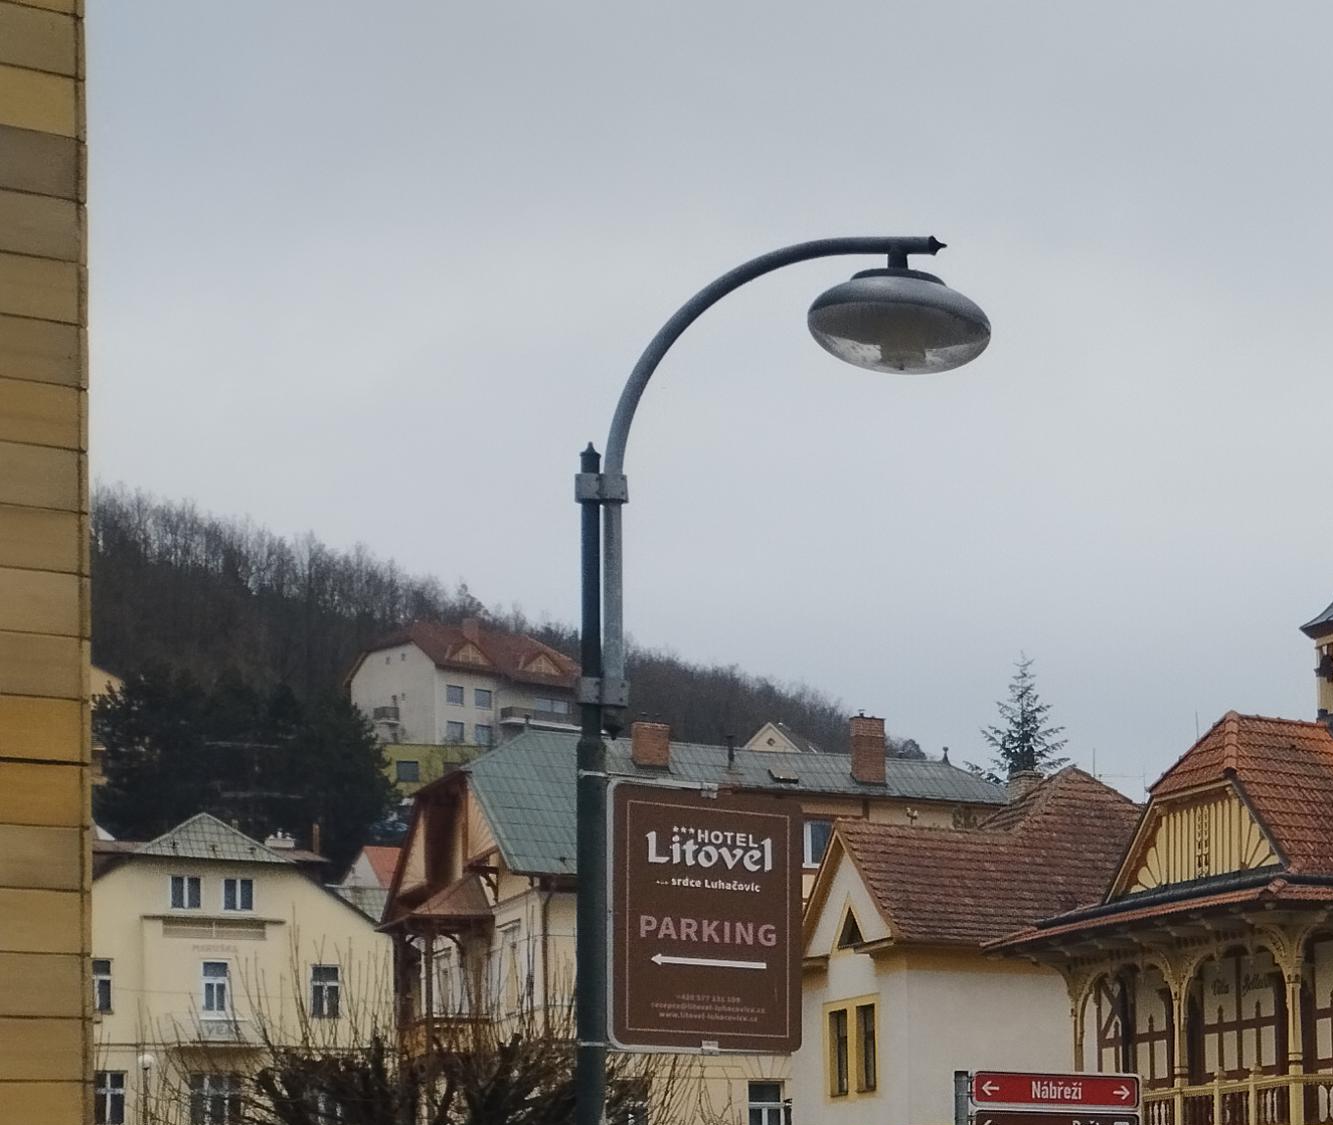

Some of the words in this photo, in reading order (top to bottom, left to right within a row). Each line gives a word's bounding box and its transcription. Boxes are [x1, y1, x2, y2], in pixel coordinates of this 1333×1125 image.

[697, 829, 759, 847] HOTEL
[645, 830, 773, 872] Litovel
[671, 876, 702, 888] srdce
[704, 879, 761, 893] Luhačovic
[639, 915, 777, 947] PARKING
[1031, 1080, 1082, 1099] Nábřeží
